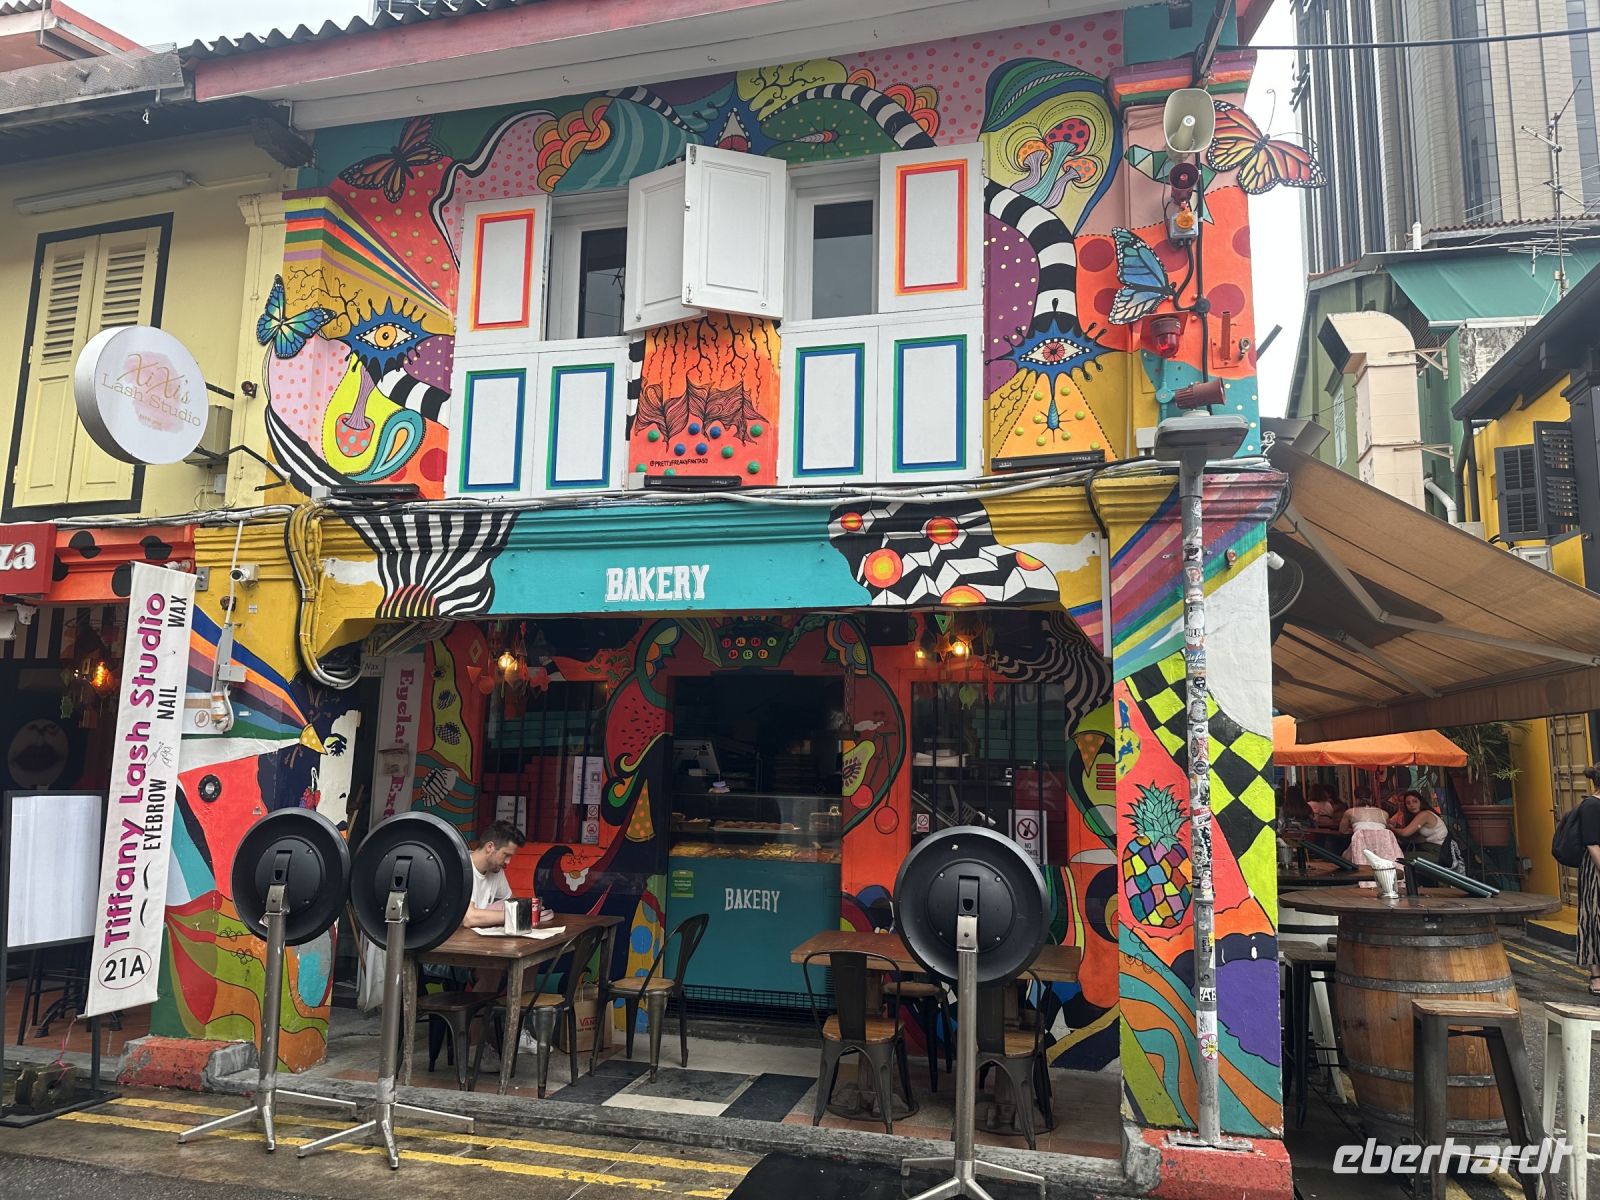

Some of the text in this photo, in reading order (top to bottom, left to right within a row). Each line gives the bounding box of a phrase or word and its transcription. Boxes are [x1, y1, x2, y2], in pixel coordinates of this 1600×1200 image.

[101, 373, 144, 402] Lash
[149, 395, 201, 427] Studio
[604, 564, 710, 602] BAKERY
[142, 595, 187, 851] EYEBROW NAIL WAX
[383, 668, 415, 820] Eyela Ext
[103, 593, 166, 949] Tiffany Lash Studio
[724, 887, 781, 913] BAKERY
[103, 955, 145, 982] 21A
